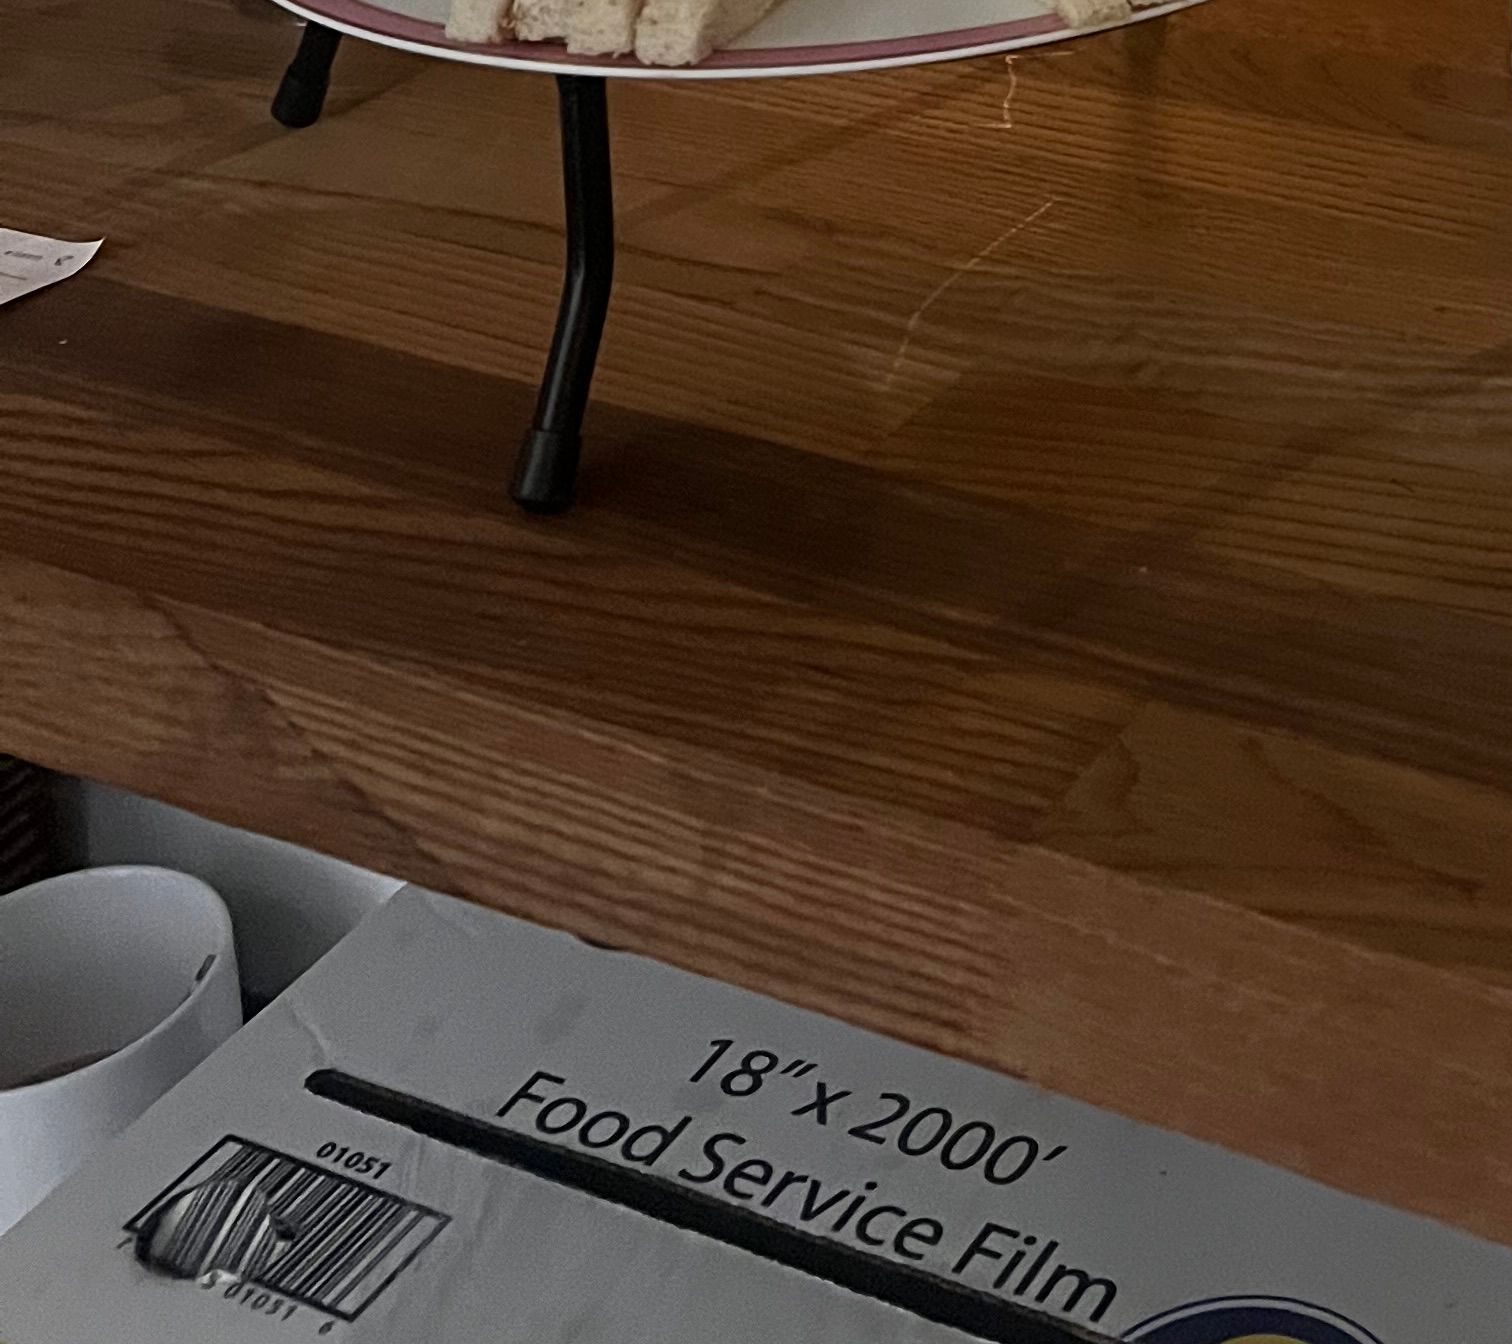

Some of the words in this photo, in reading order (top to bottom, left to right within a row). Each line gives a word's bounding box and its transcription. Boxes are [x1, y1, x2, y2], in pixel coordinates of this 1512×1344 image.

[316, 1140, 393, 1180] 01051
[496, 1070, 693, 1167] Food
[679, 1131, 944, 1262] Service
[951, 1221, 1118, 1324] Film
